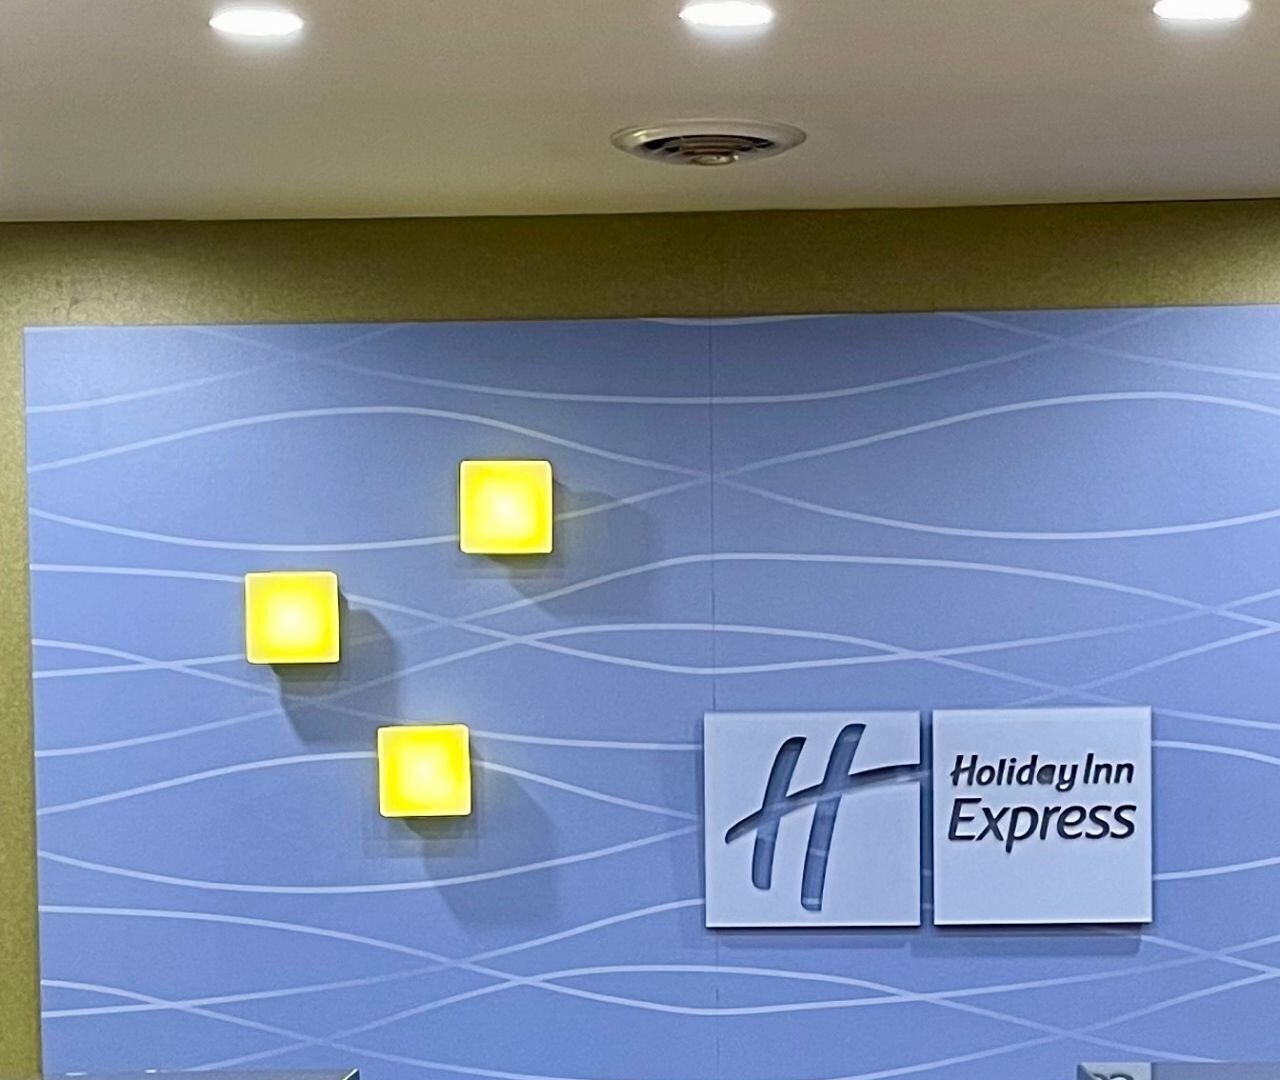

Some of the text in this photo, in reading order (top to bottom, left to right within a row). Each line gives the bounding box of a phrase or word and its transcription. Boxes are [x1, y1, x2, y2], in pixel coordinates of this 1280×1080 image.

[951, 753, 1134, 792] Holiday Inn
[948, 797, 1137, 853] Express
